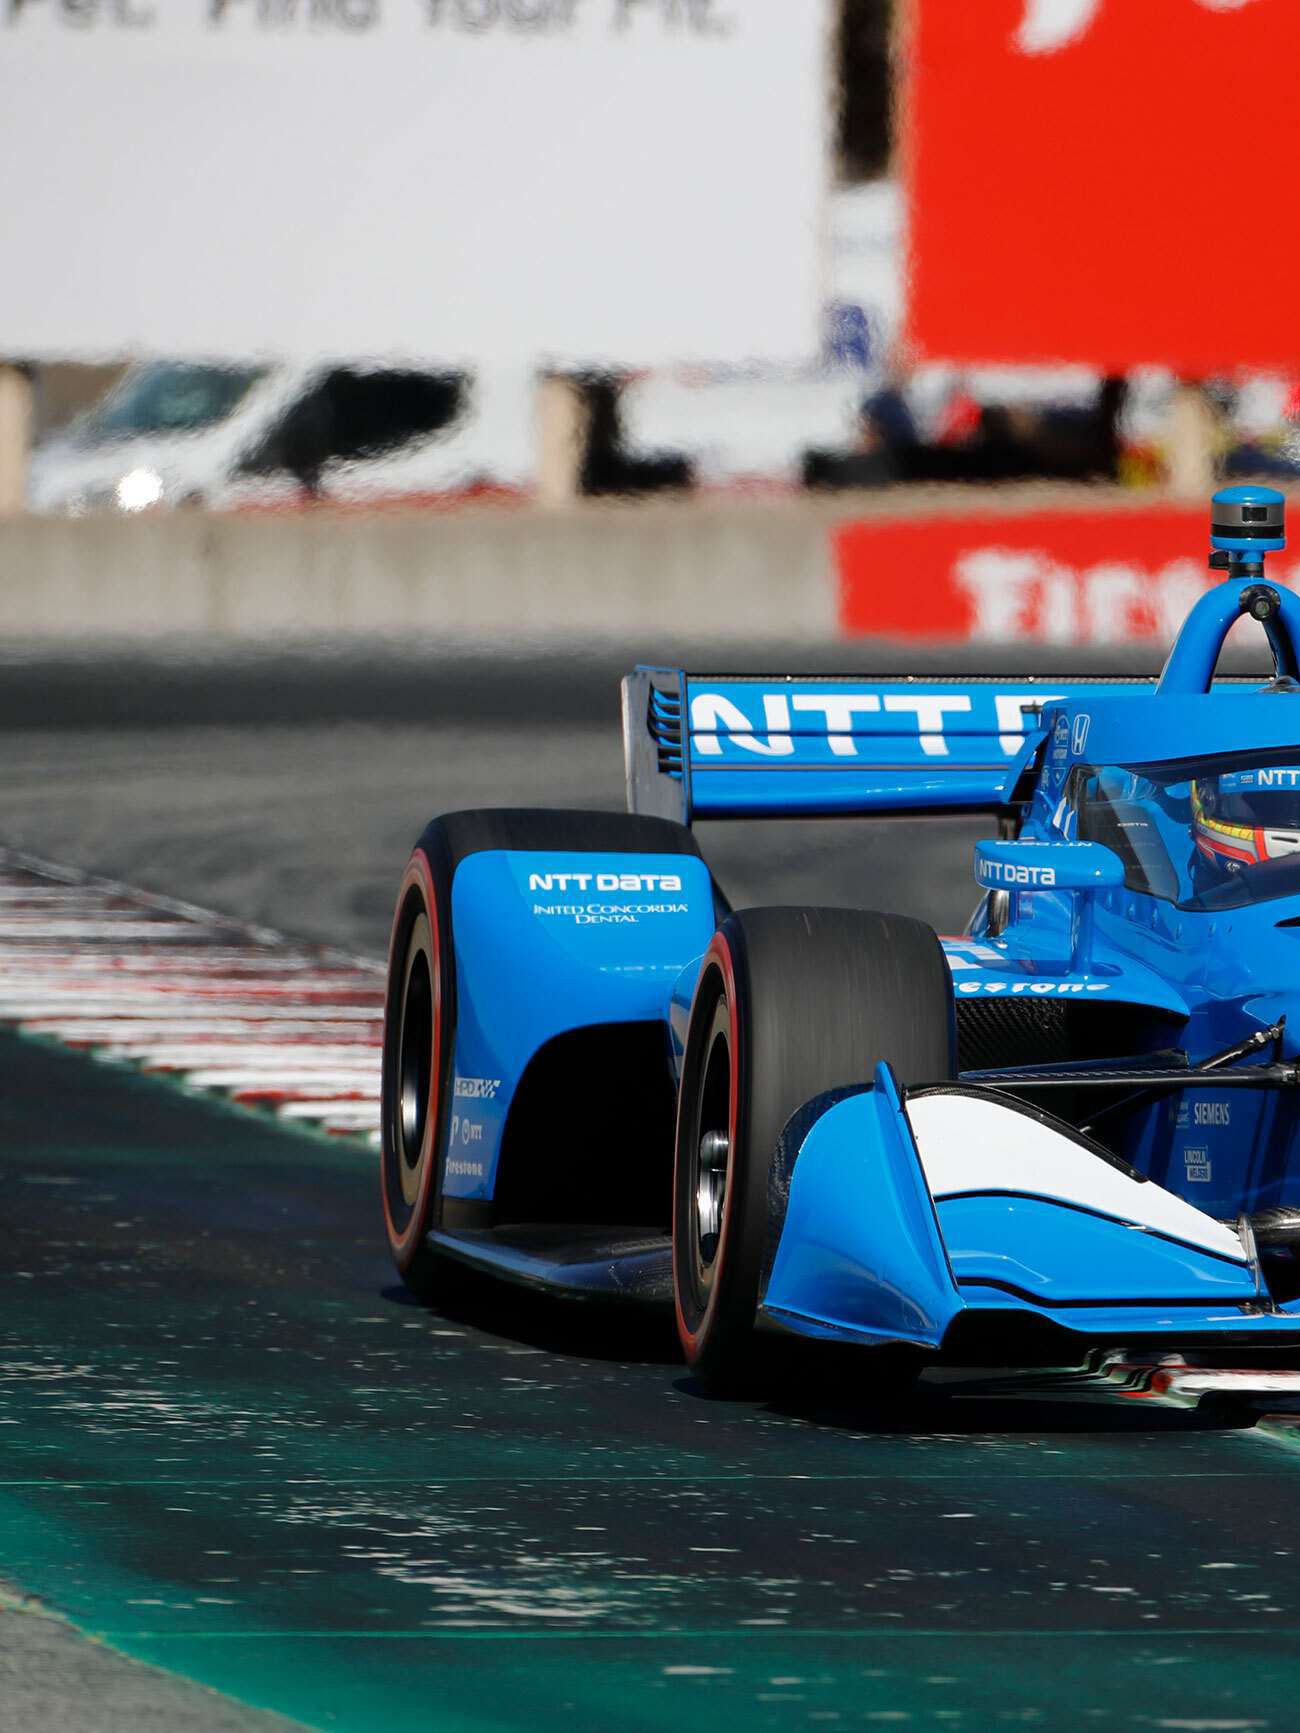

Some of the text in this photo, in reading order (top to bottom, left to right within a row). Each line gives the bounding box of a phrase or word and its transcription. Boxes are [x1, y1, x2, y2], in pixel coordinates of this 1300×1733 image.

[691, 694, 972, 757] NTT
[1257, 769, 1300, 785] NTT
[979, 858, 1003, 880] NTT
[528, 873, 593, 892] NTT
[575, 914, 640, 925] DENTAL
[1194, 1102, 1231, 1125] SIEMENS
